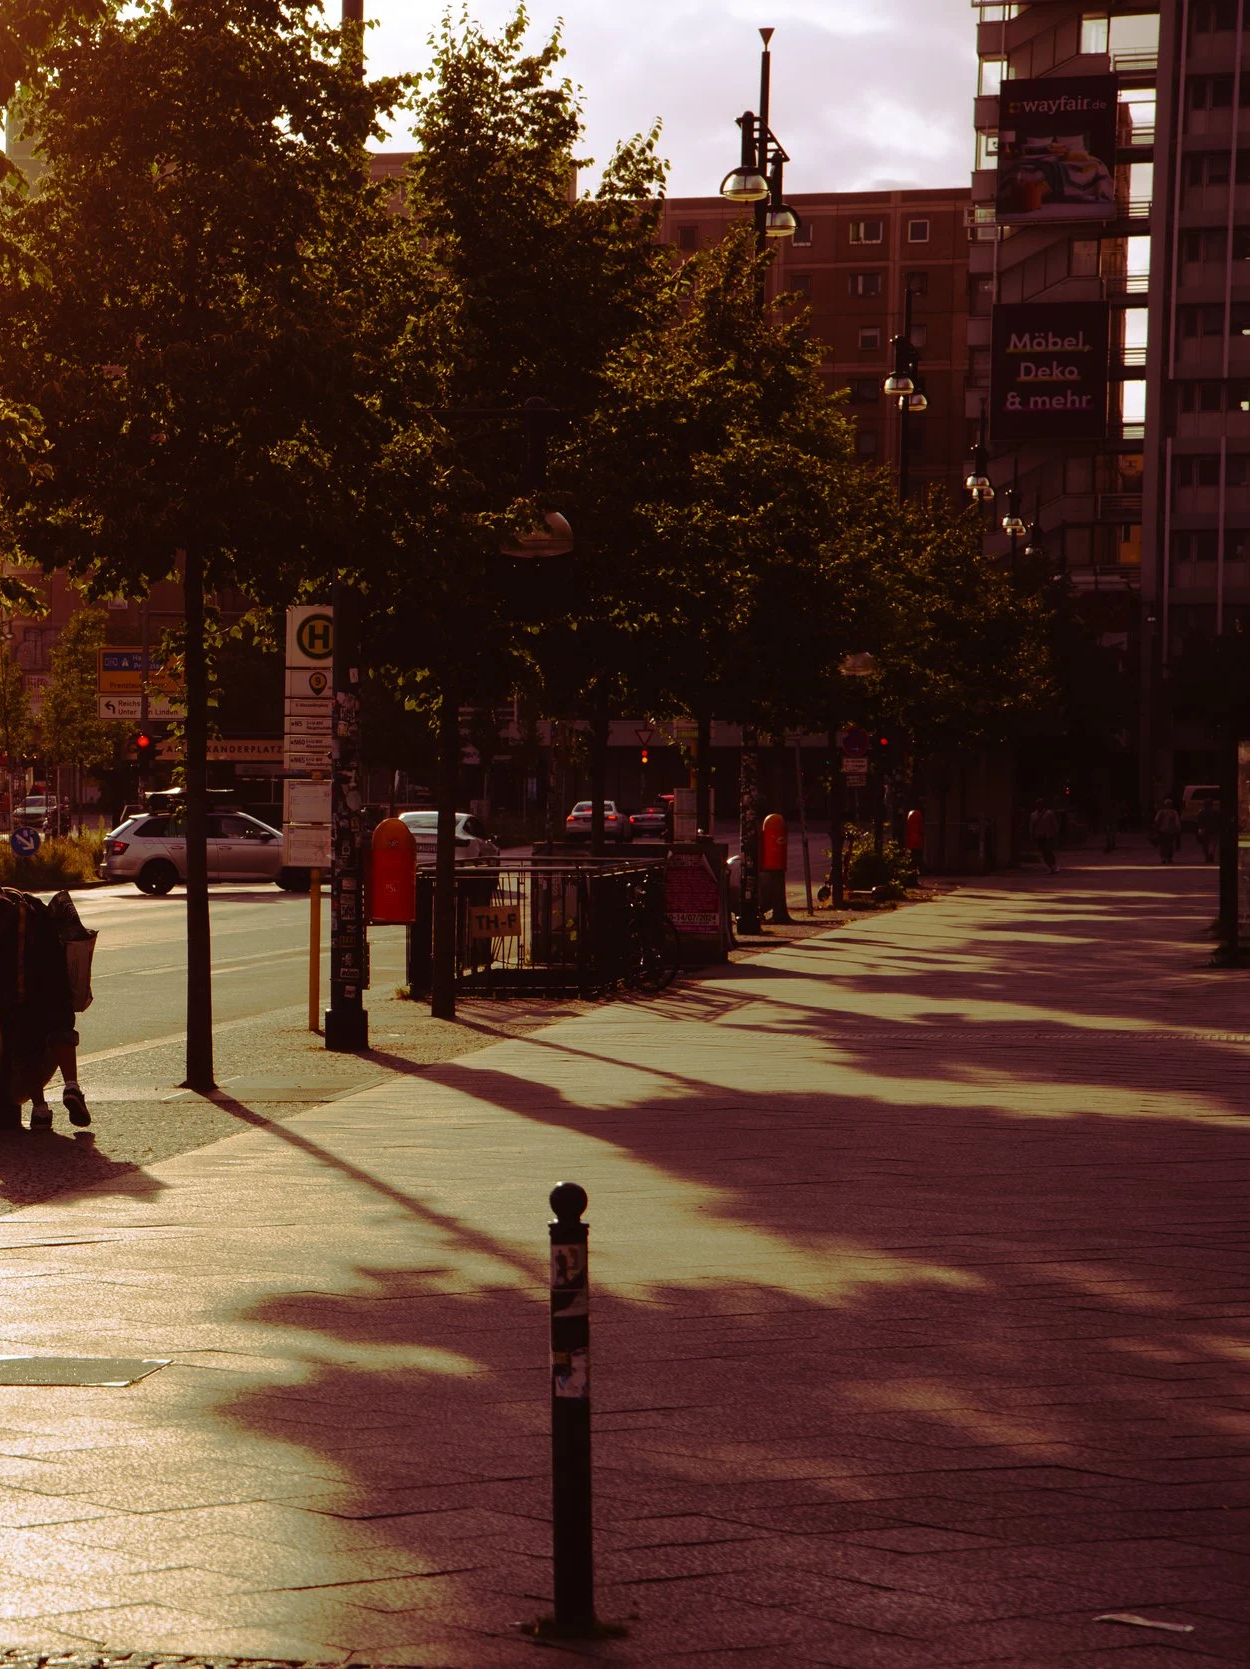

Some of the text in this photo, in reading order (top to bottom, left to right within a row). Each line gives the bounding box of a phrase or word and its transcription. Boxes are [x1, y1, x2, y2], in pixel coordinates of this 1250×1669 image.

[1023, 96, 1107, 115] wayfair.de
[1010, 331, 1092, 352] Möbel,
[1019, 361, 1078, 380] Deko
[1006, 389, 1092, 409] & mehr
[309, 624, 329, 649] H
[206, 745, 282, 753] XANDERPLATZ
